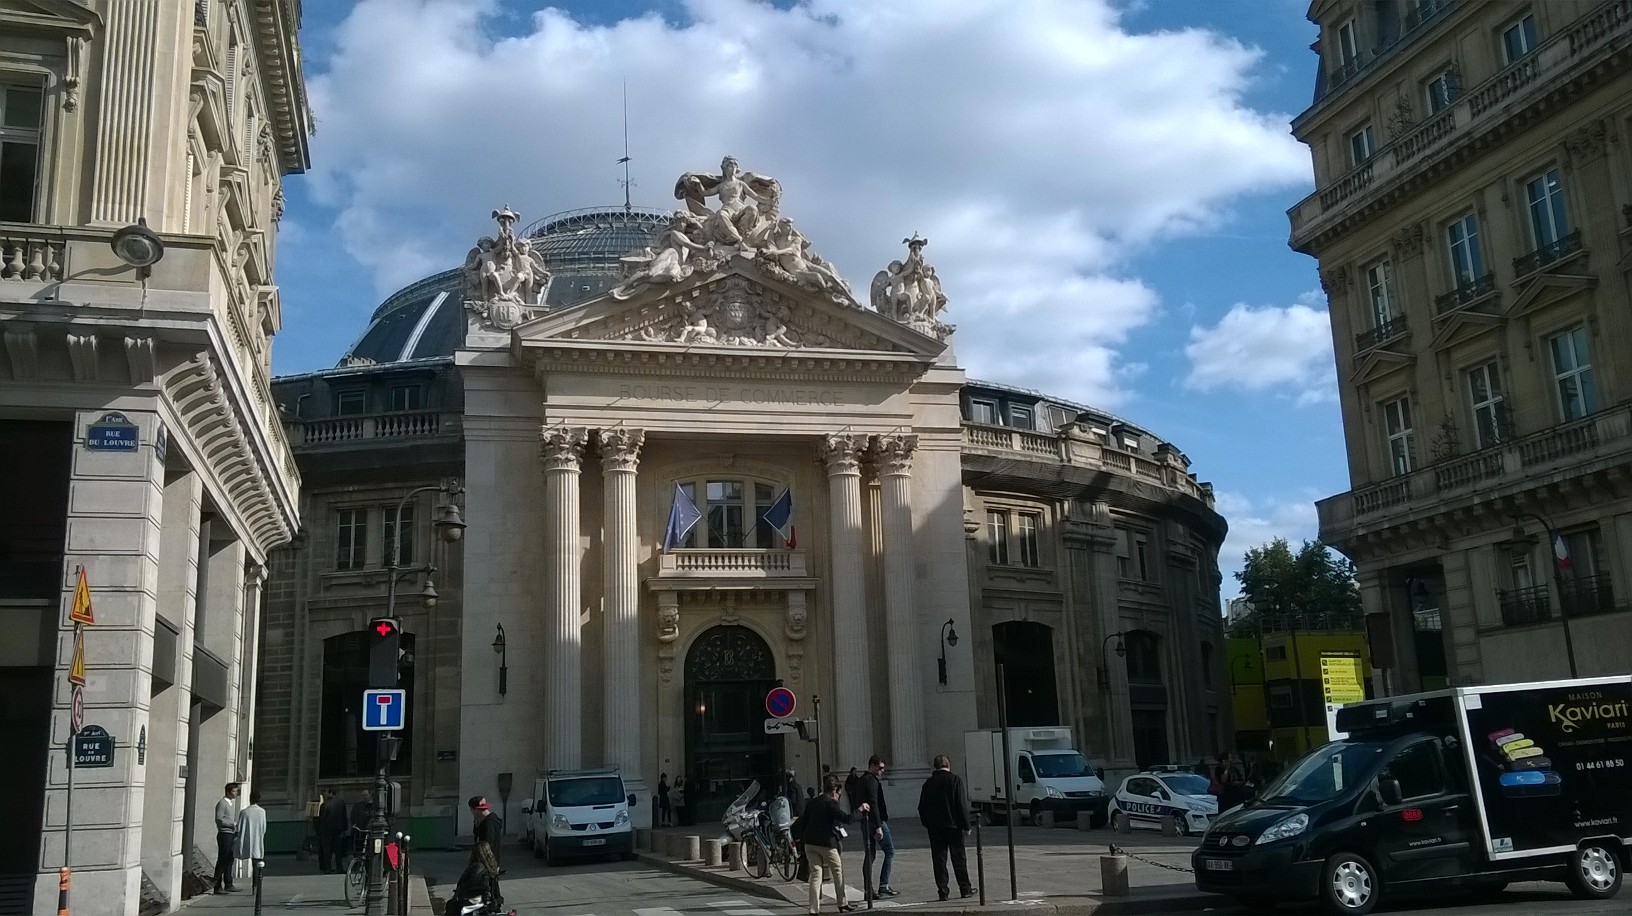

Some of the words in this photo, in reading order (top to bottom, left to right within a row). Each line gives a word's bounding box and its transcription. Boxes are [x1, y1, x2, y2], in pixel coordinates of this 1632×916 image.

[619, 384, 697, 402] BOURSE
[706, 387, 730, 403] DE
[740, 388, 845, 407] COMMERCE
[105, 430, 120, 438] RUE
[103, 439, 136, 447] LOUVRE
[1568, 691, 1603, 701] MAISON
[1548, 699, 1629, 733] Kaviari
[1606, 721, 1626, 729] PARIS
[1575, 762, 1585, 771] 01
[1586, 761, 1596, 770] 44
[1595, 760, 1605, 768] 61
[1615, 758, 1625, 767] 50
[1126, 801, 1155, 814] POLICE
[1573, 816, 1619, 828] www.kaviari.fr
